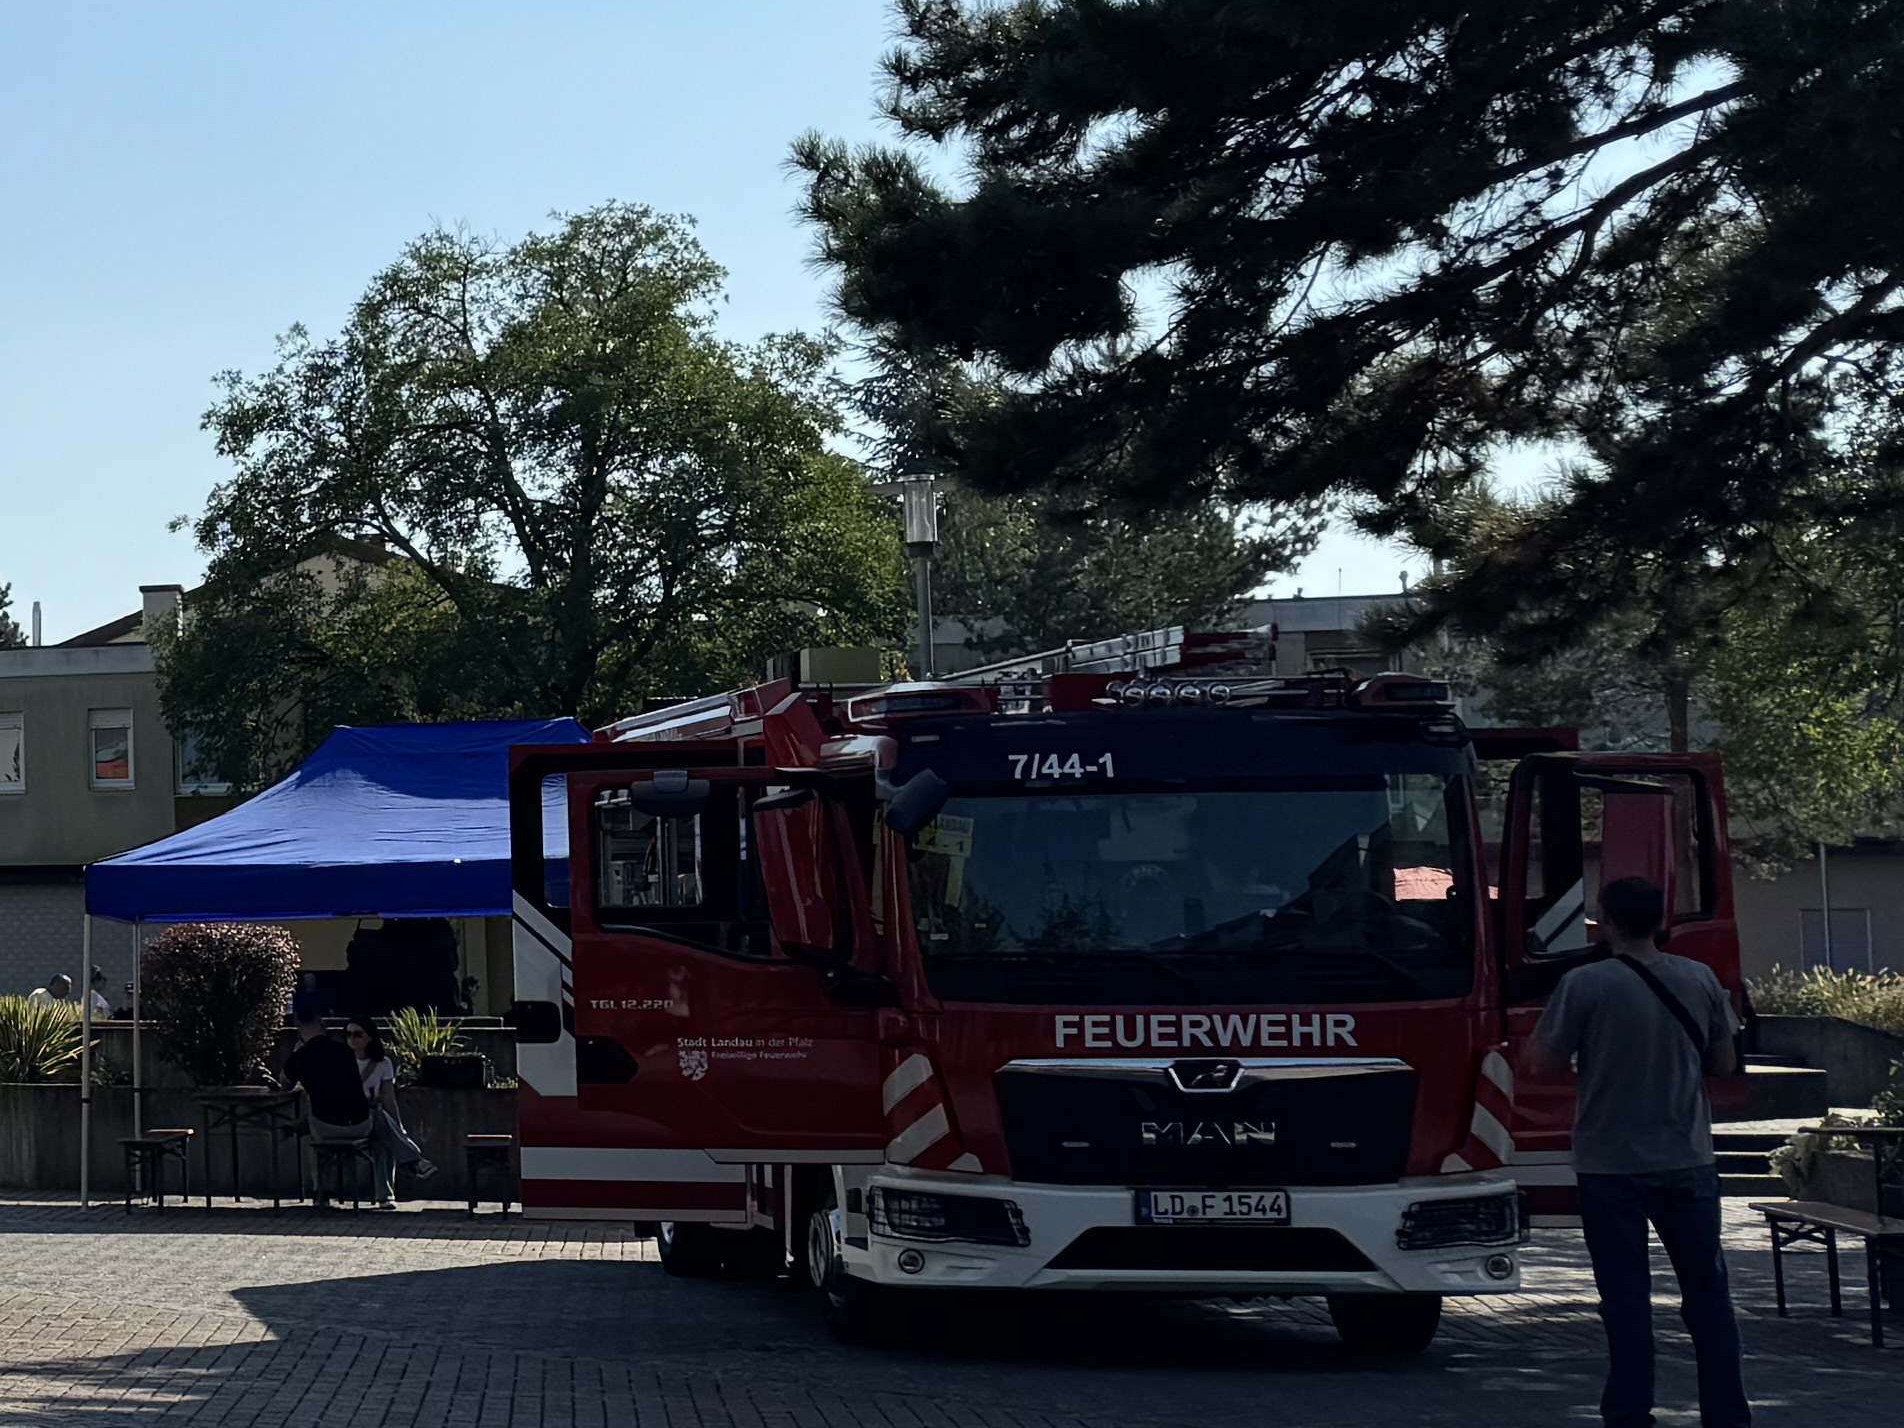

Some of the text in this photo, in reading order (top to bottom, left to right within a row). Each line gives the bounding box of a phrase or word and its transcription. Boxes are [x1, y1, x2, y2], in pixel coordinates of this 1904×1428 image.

[1008, 752, 1115, 779] 7/44-1
[677, 1036, 707, 1048] Stadt
[711, 1036, 754, 1048] Landau
[768, 1037, 786, 1047] der
[788, 1037, 814, 1047] Pfalz
[1054, 1013, 1359, 1049] FEUERWEHR
[759, 1050, 809, 1060] Feuerwehr
[1141, 1121, 1276, 1145] MAN
[1153, 1194, 1284, 1216] LD F 1544
